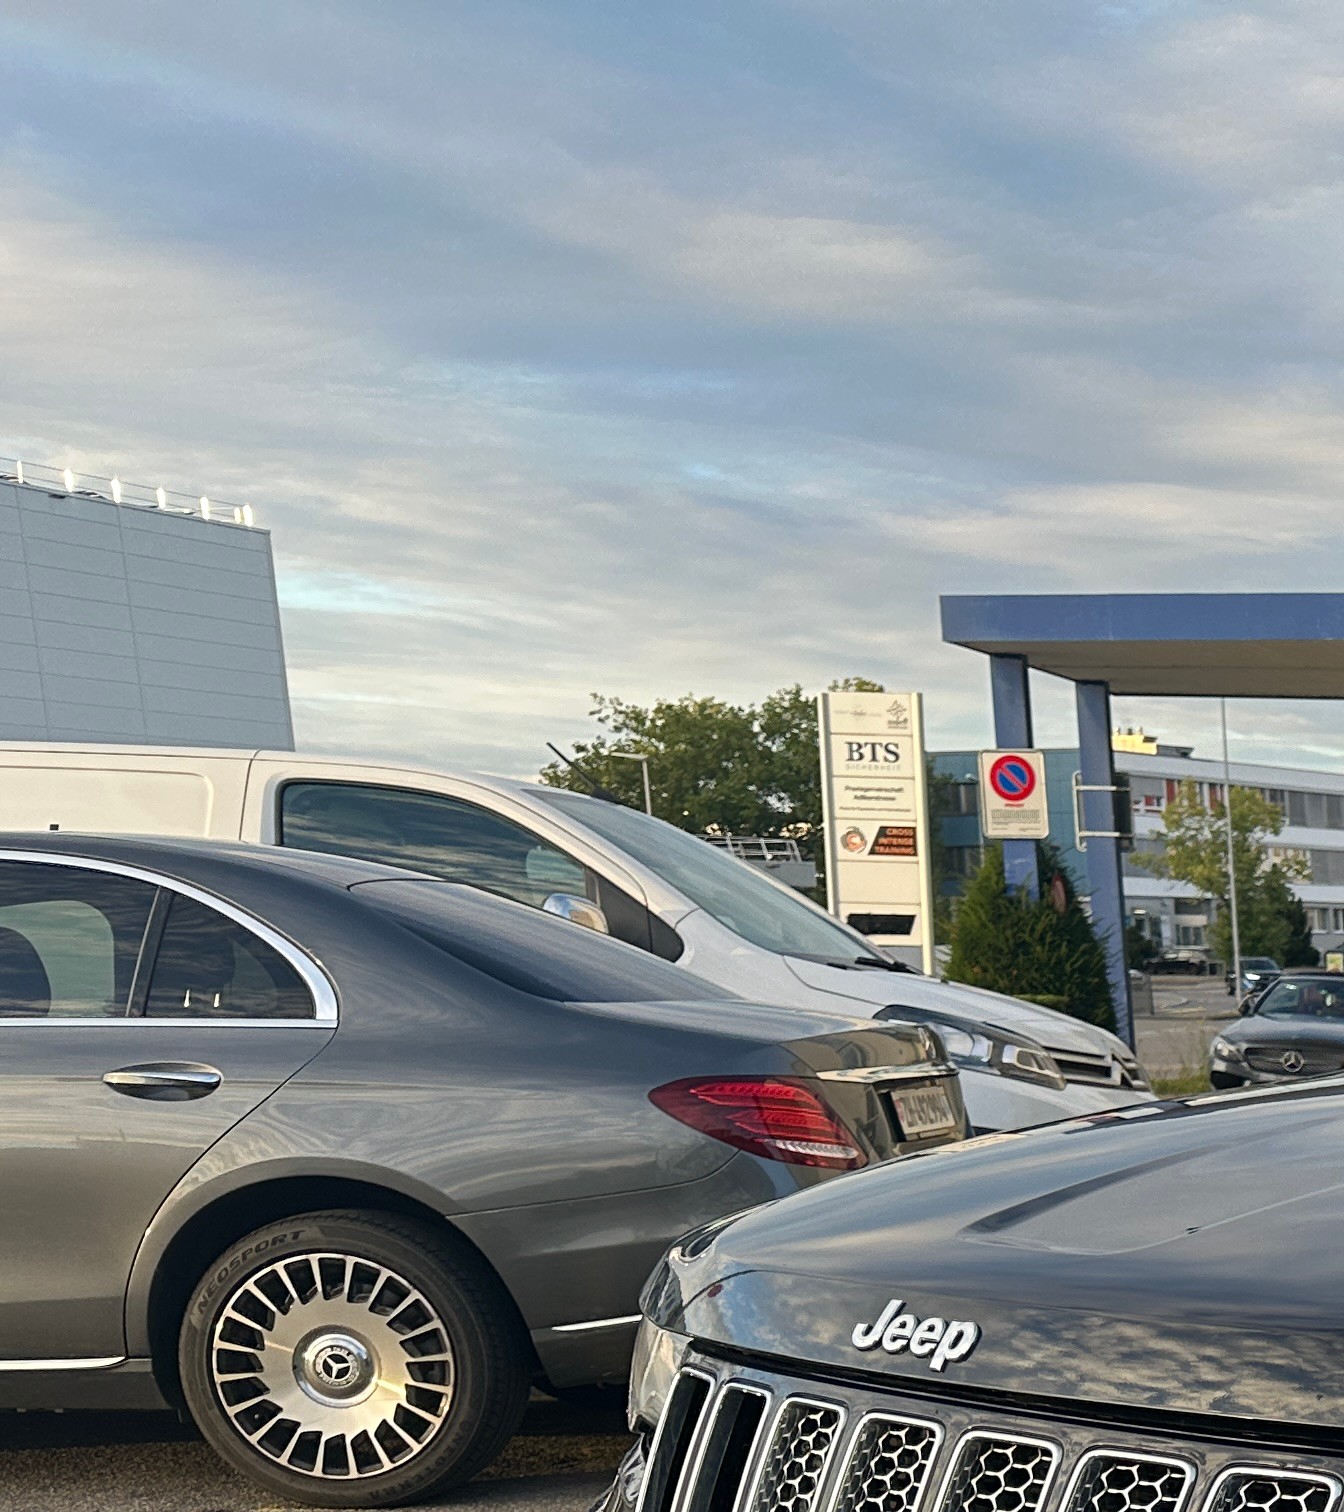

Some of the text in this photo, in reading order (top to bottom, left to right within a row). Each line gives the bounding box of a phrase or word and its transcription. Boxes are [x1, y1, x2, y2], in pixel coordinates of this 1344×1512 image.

[845, 741, 900, 762] BTS
[196, 1229, 306, 1314] NEOSPORT
[851, 1299, 982, 1372] Jeep
